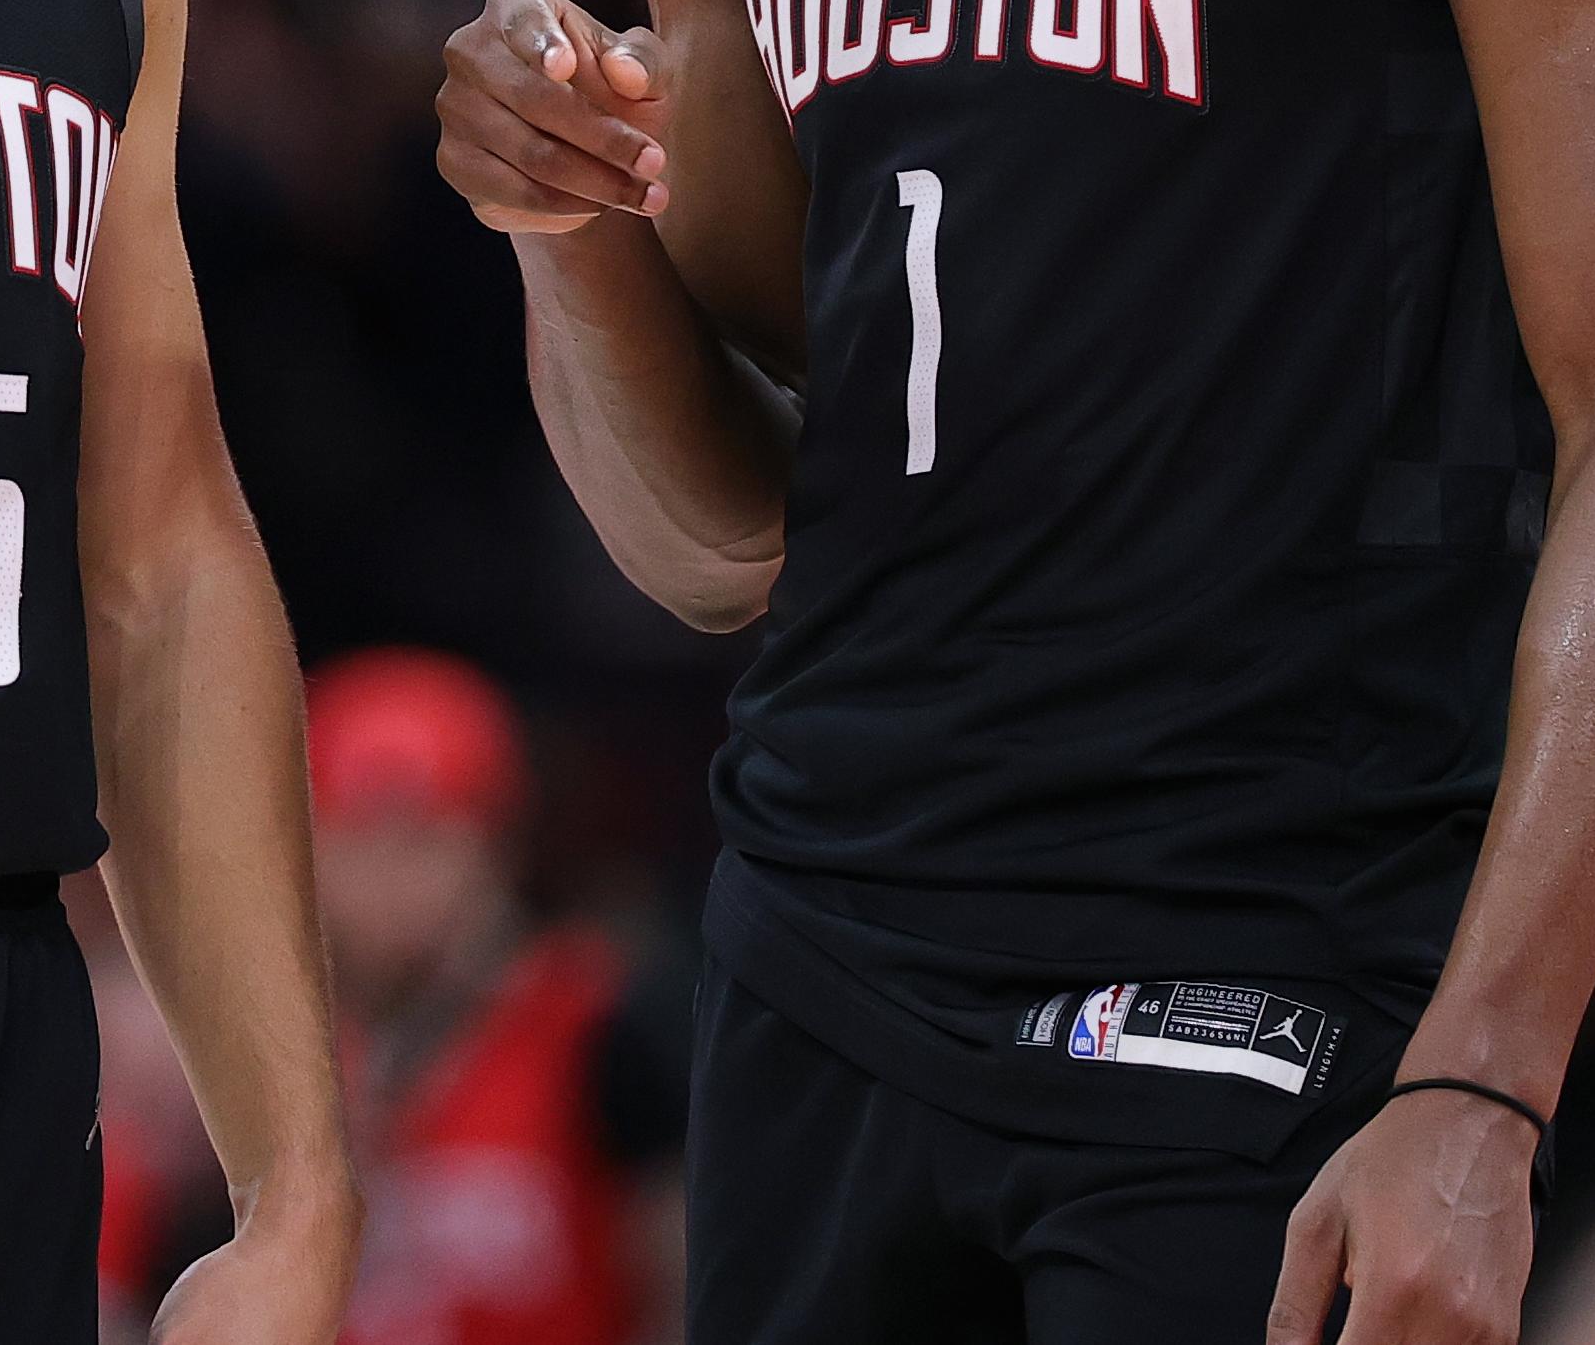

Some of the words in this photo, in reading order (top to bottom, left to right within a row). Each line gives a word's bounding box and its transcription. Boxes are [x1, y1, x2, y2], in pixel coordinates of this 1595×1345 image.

[896, 169, 943, 476] 1
[1179, 986, 1261, 1004] ENGINEERED
[1137, 1000, 1161, 1014] 46
[1074, 1036, 1093, 1052] NBA
